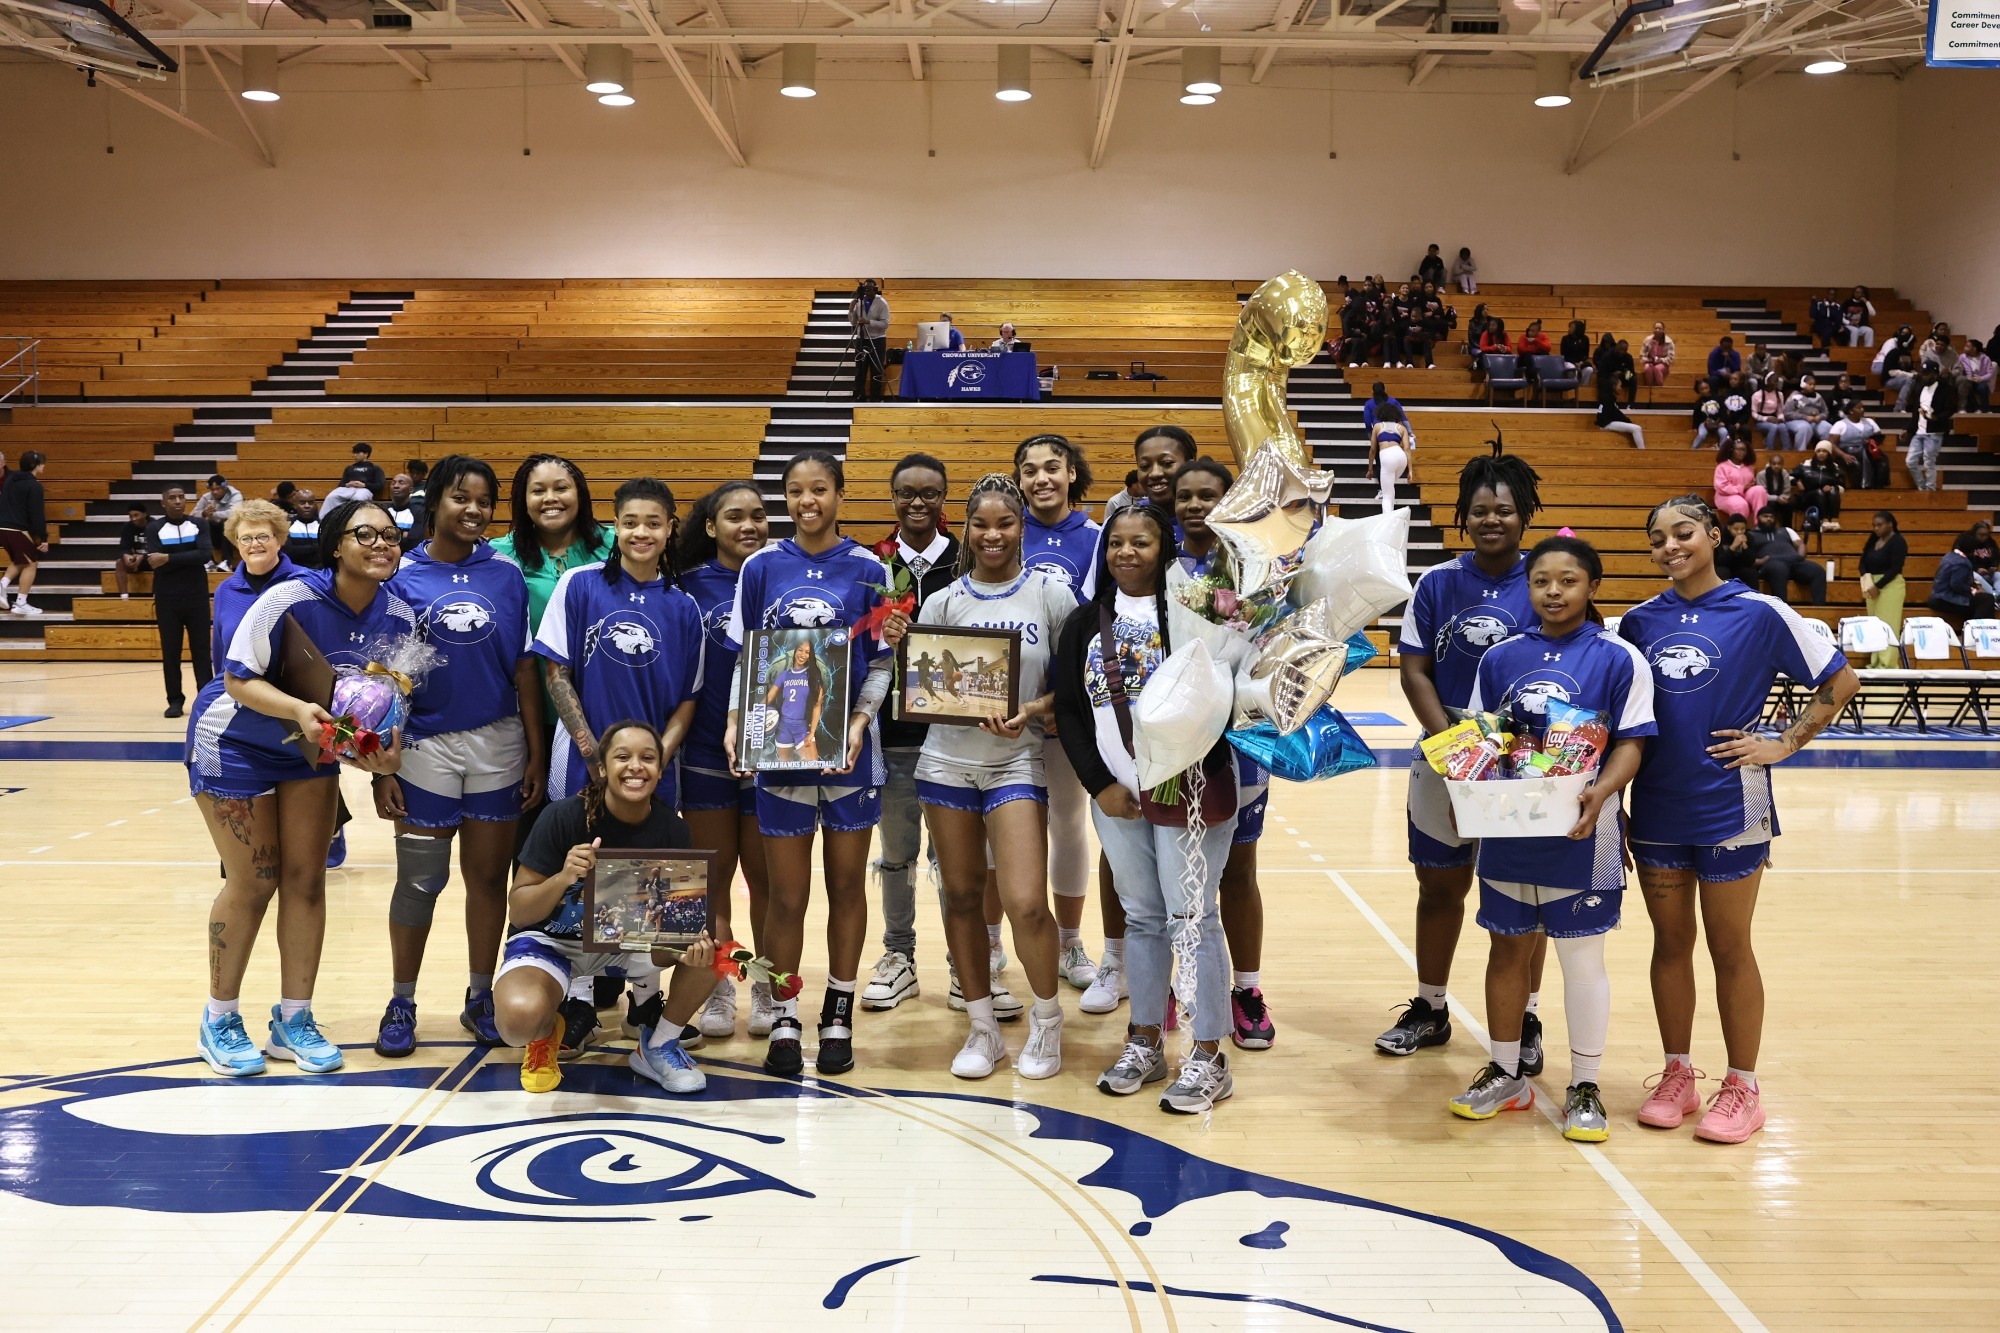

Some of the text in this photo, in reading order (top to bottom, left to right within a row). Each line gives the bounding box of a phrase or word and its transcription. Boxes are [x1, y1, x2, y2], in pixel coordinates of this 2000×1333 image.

[1951, 21, 2000, 29] Career Deve
[757, 636, 768, 683] 2026
[1124, 675, 1141, 688] #2
[757, 685, 765, 695] 2
[789, 688, 797, 702] 2
[752, 704, 765, 748] BROWN
[756, 760, 836, 769] CHOWAN HAWKS BASKETBALL
[1468, 752, 1491, 782] BODYARMOR
[1476, 792, 1549, 821] YAZ
